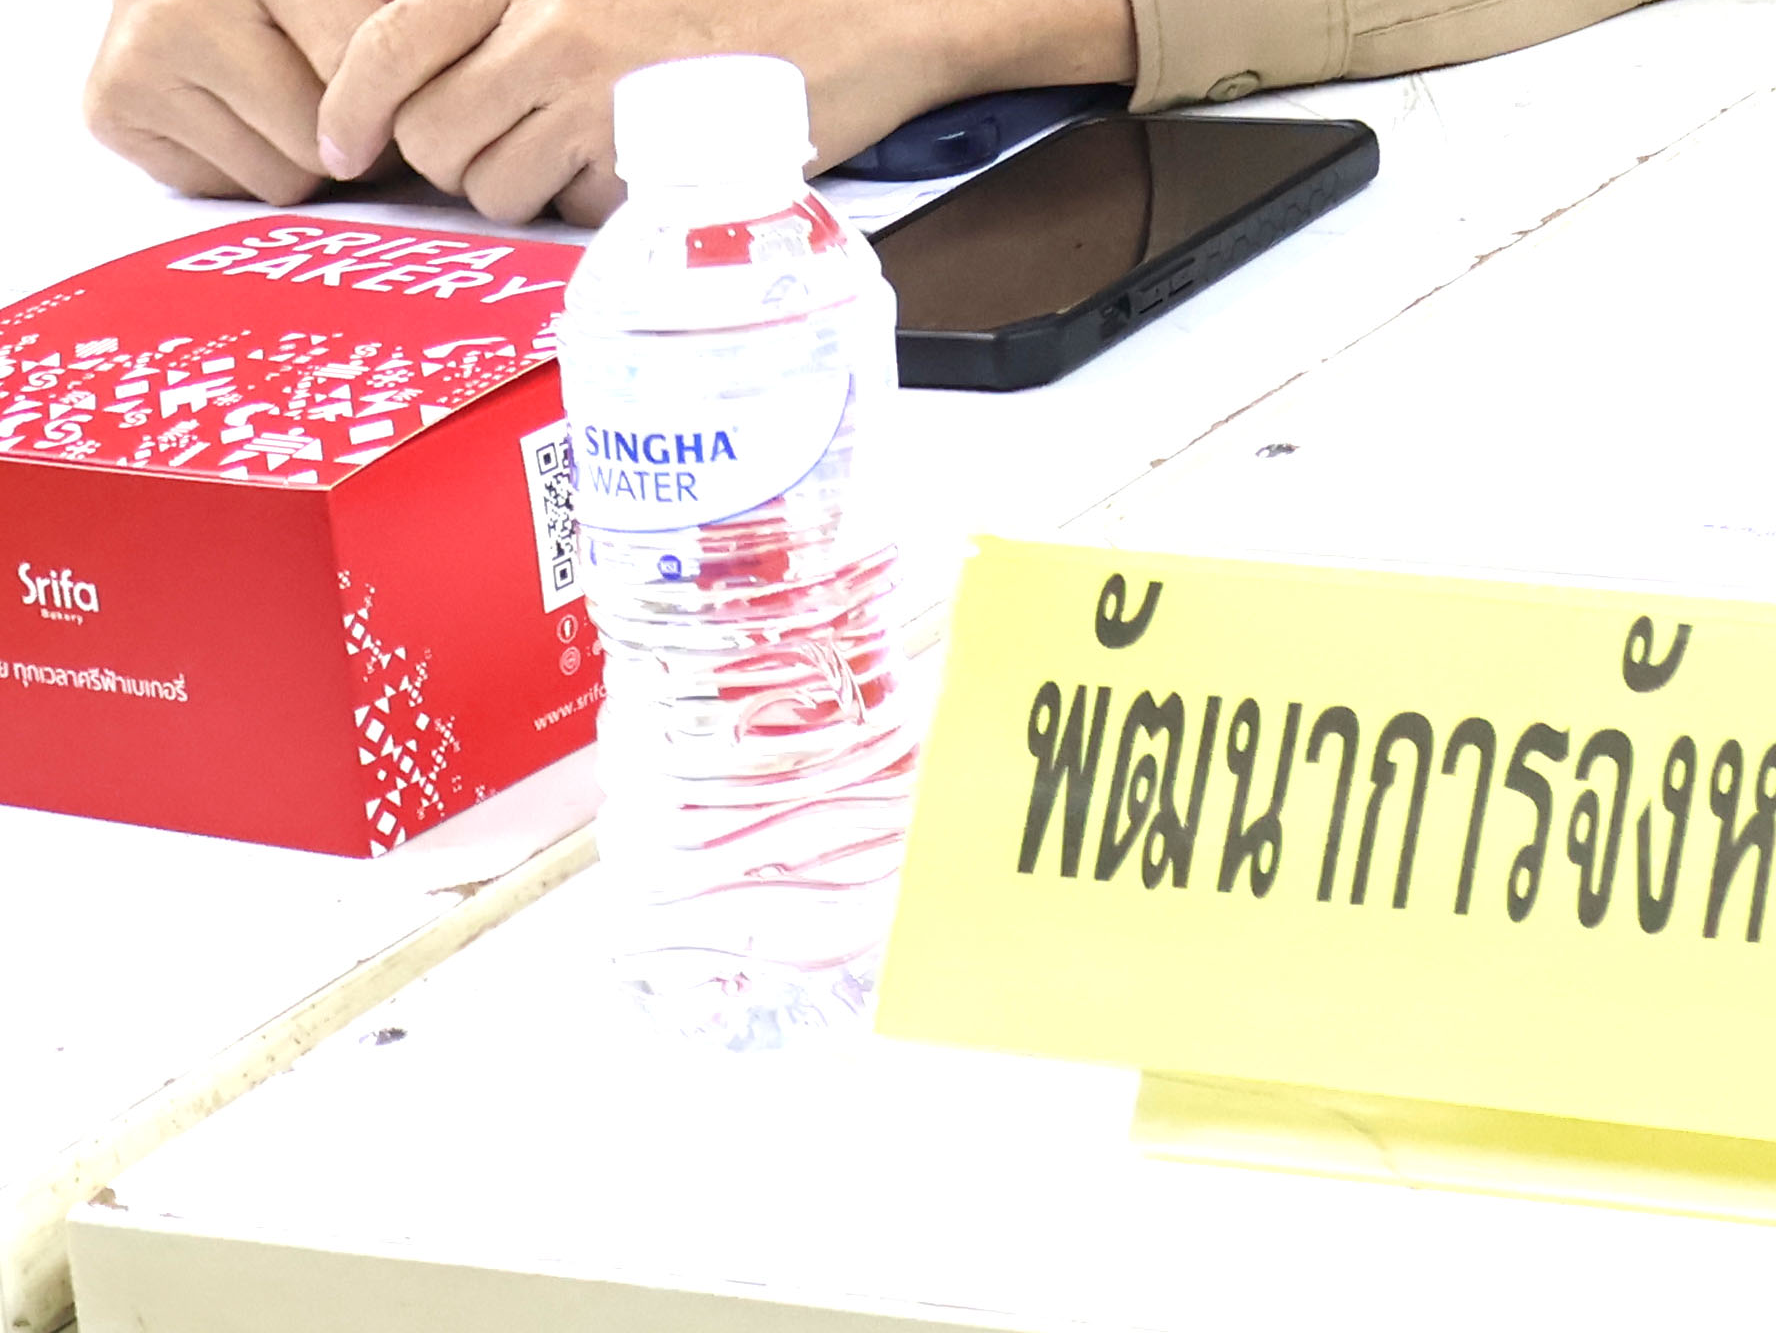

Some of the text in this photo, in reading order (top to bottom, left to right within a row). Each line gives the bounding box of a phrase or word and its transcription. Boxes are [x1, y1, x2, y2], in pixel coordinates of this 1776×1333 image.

[241, 226, 516, 270] SRIFA
[166, 245, 567, 305] BAKERY
[585, 424, 738, 465] SINGHA
[588, 464, 699, 503] WATER
[18, 562, 100, 613] Srifa
